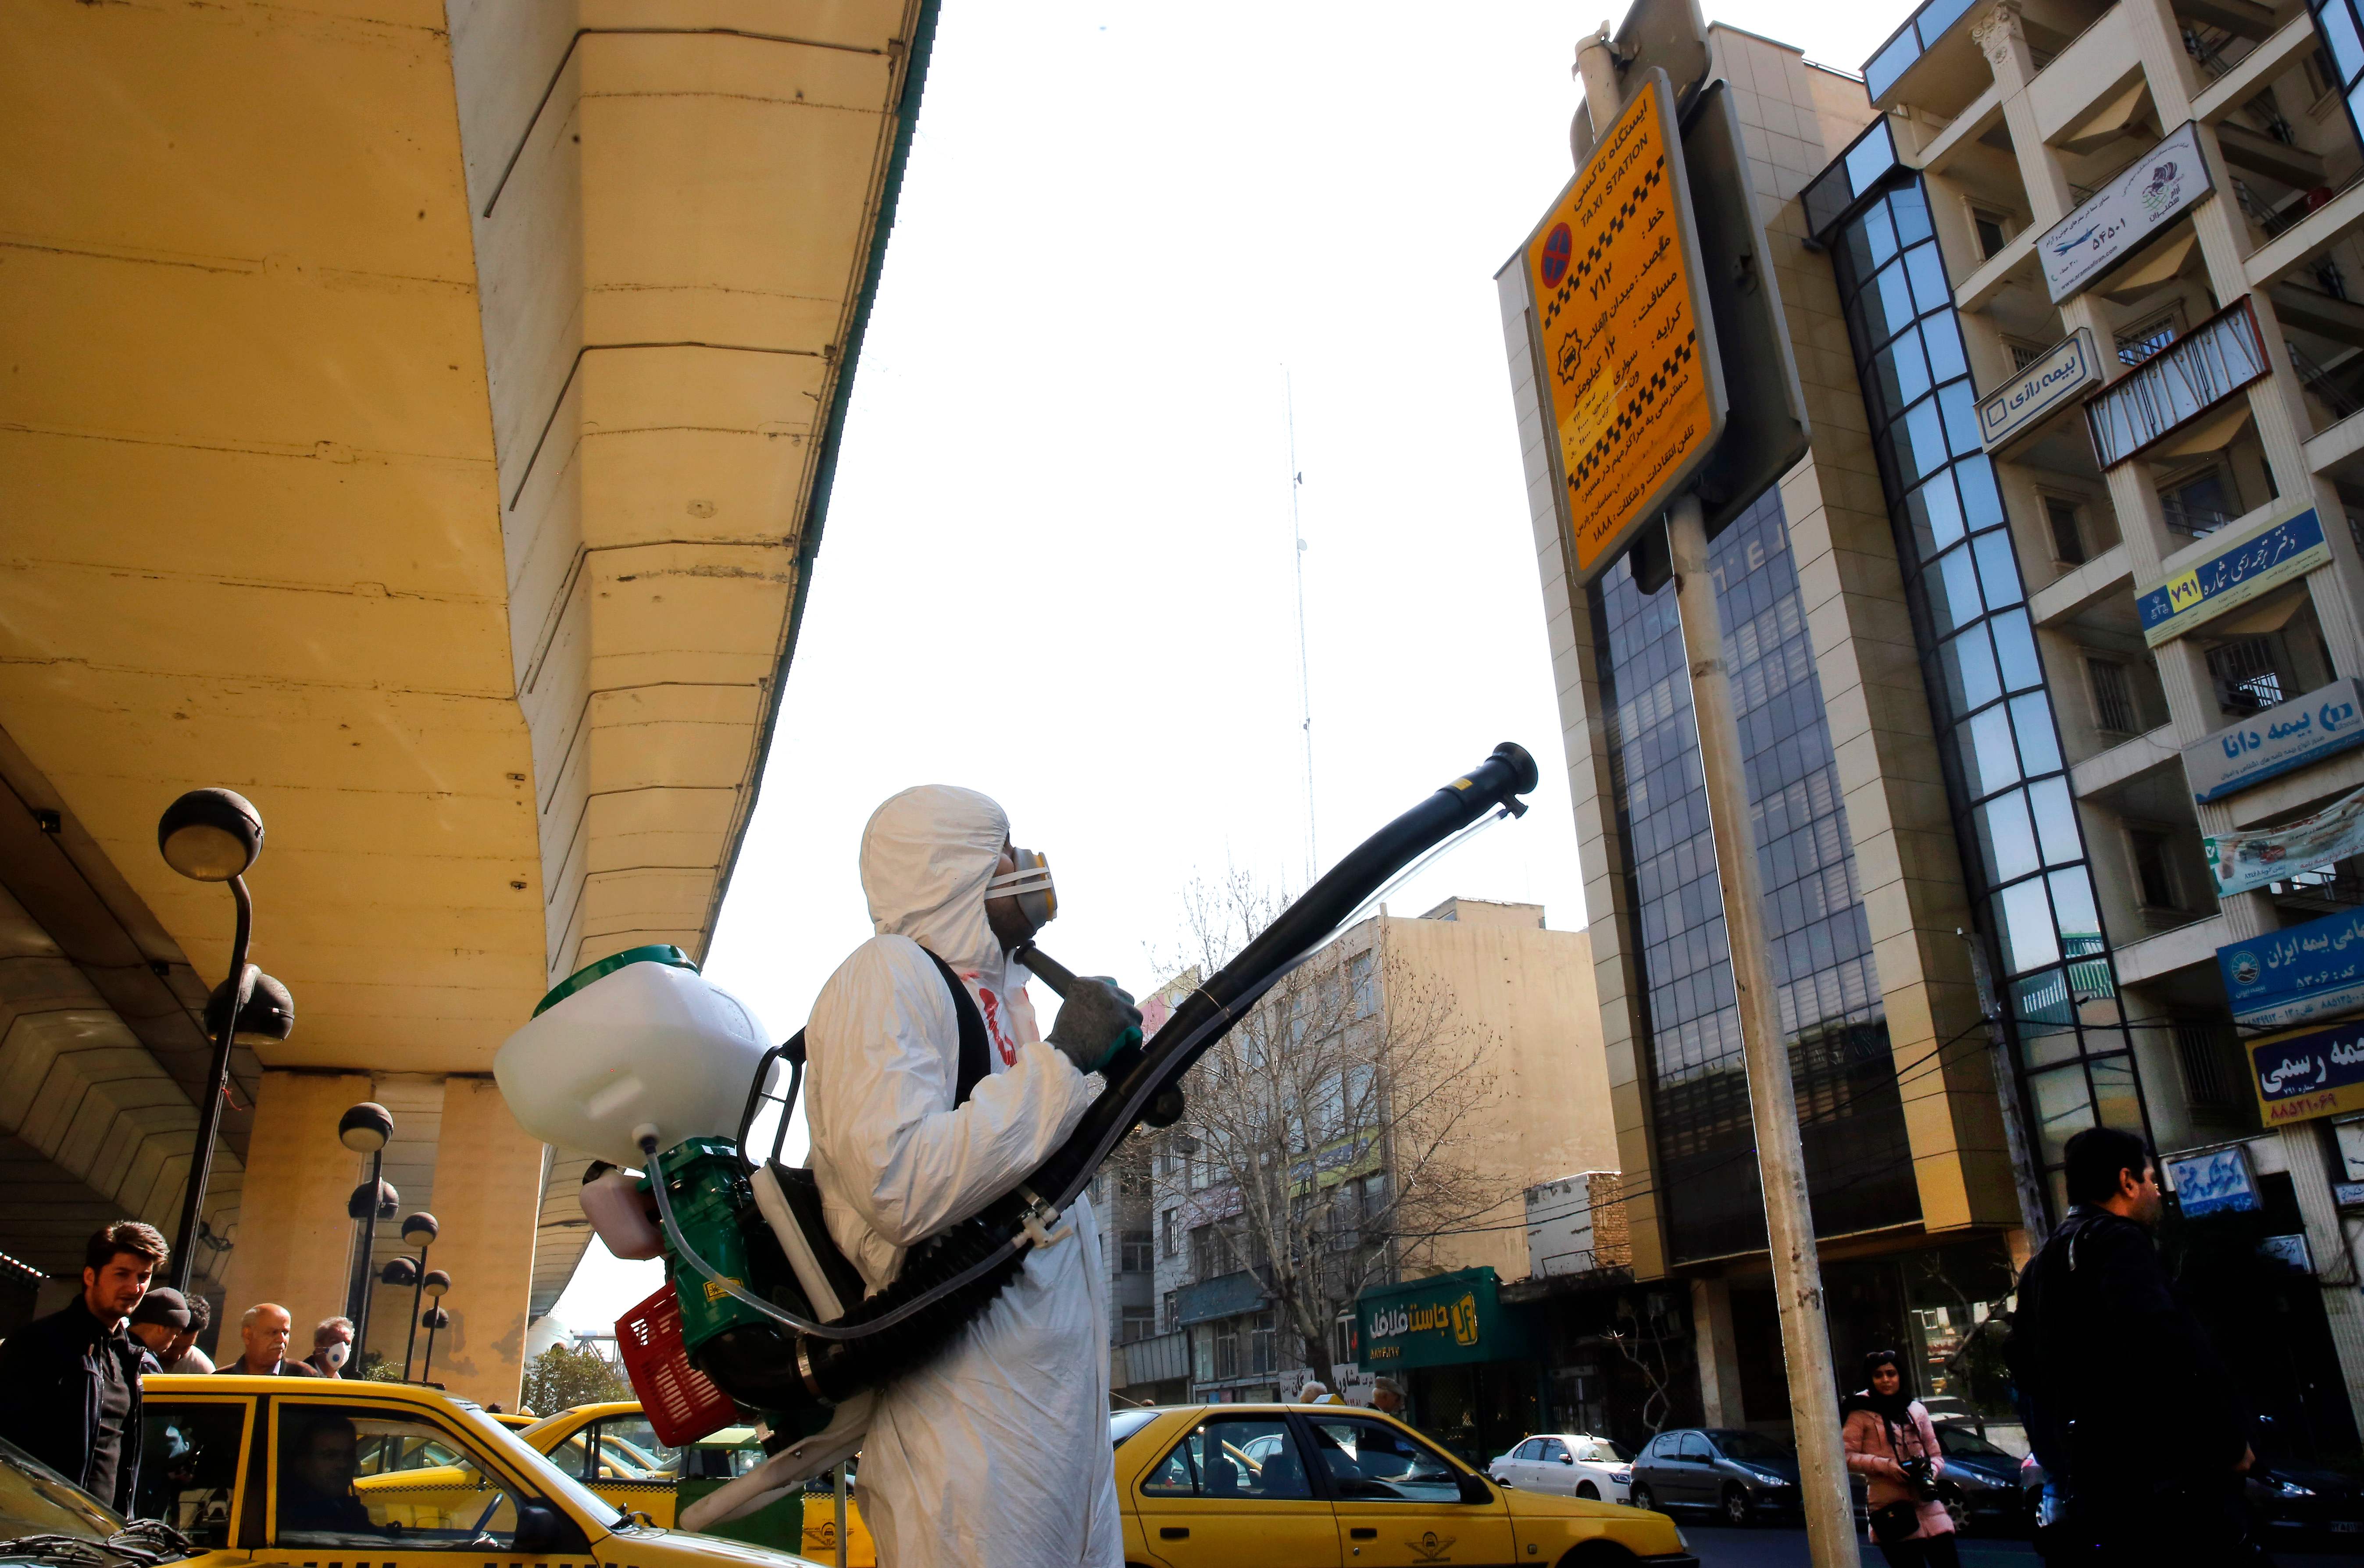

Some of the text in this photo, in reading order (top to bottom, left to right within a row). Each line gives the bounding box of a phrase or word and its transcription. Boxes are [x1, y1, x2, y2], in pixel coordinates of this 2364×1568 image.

[1575, 99, 1647, 212] ایستگاه تاکسی
[1581, 133, 1647, 227] TAXI STATION
[2093, 218, 2125, 250] ۵۴۵۰۱
[1590, 261, 1611, 301] ۷۱۲
[1610, 283, 1634, 318] میدان
[1574, 356, 1601, 408] کیلومتر
[1614, 350, 1637, 385] سواری
[2009, 356, 2076, 410] بیمه رازی
[1656, 374, 1688, 419] دسترسی
[1646, 415, 1654, 426] به
[1625, 426, 1645, 456] مراکز
[1677, 424, 1694, 454] تلفن
[1611, 449, 1625, 473] مهم
[1646, 443, 1677, 485] انتقادات
[1641, 483, 1645, 495] و
[1593, 516, 1612, 542] ۱۸۸۸
[2251, 539, 2268, 569] ترجمه
[2272, 526, 2295, 565] دفتر
[2204, 561, 2227, 595] شماره
[2231, 553, 2249, 582] رسمی
[2171, 578, 2197, 603] ۷۹۱
[2268, 712, 2310, 739] بیمه
[2221, 730, 2260, 759] دانا
[2268, 936, 2299, 969] ایران
[2303, 934, 2330, 953] بیمه
[2261, 1055, 2326, 1093] رسمی
[2283, 1083, 2314, 1095] شماره ۷۹۱
[1369, 1303, 1449, 1339] جاست فلافل
